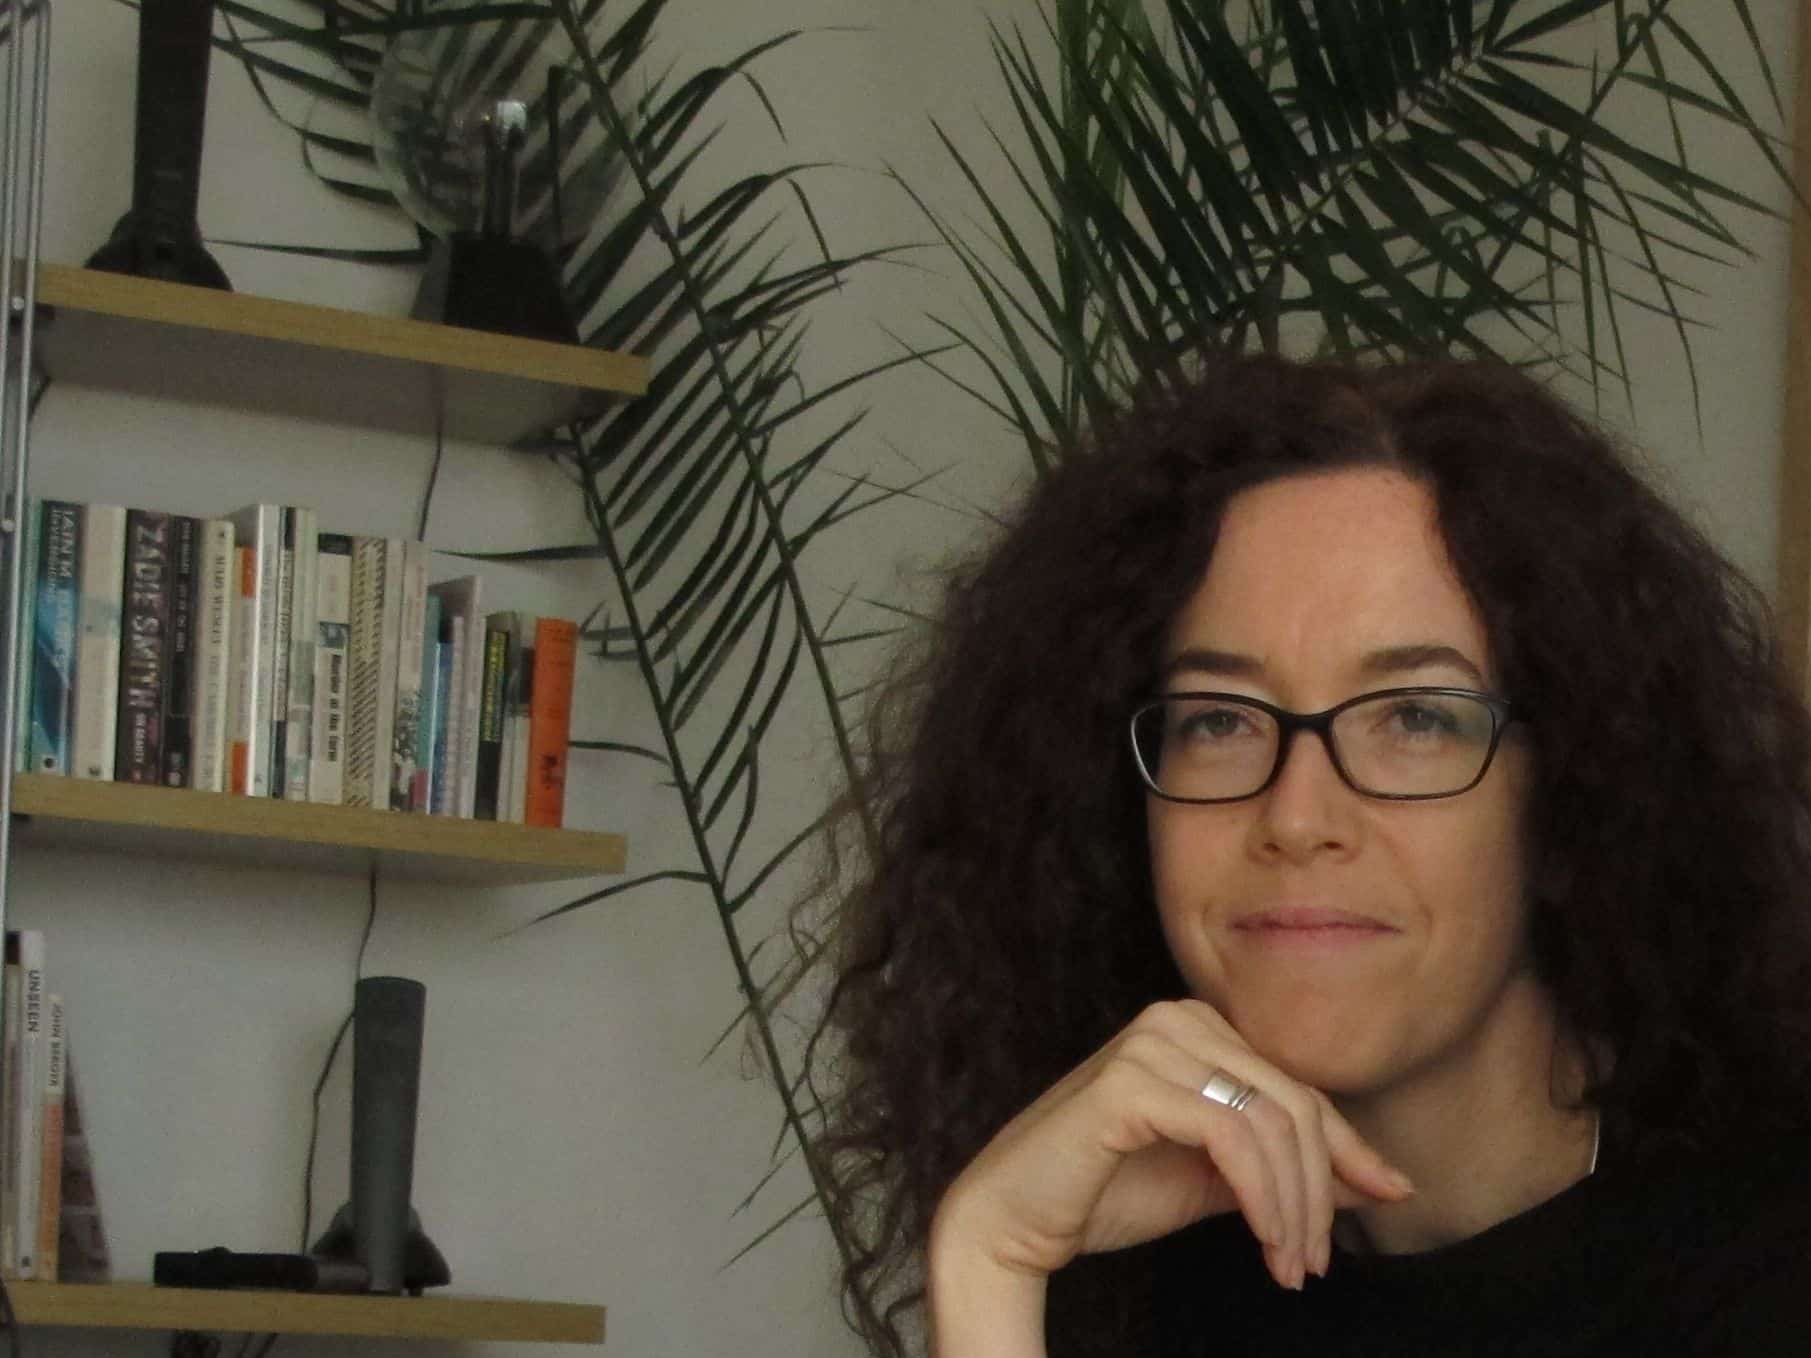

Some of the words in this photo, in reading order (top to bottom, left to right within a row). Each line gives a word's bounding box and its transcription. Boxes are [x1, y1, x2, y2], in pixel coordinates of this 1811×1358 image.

[61, 510, 75, 554] IAIN
[132, 525, 164, 608] ZADIE
[128, 614, 162, 708] SMITH
[28, 969, 41, 1033] UNSEEN
